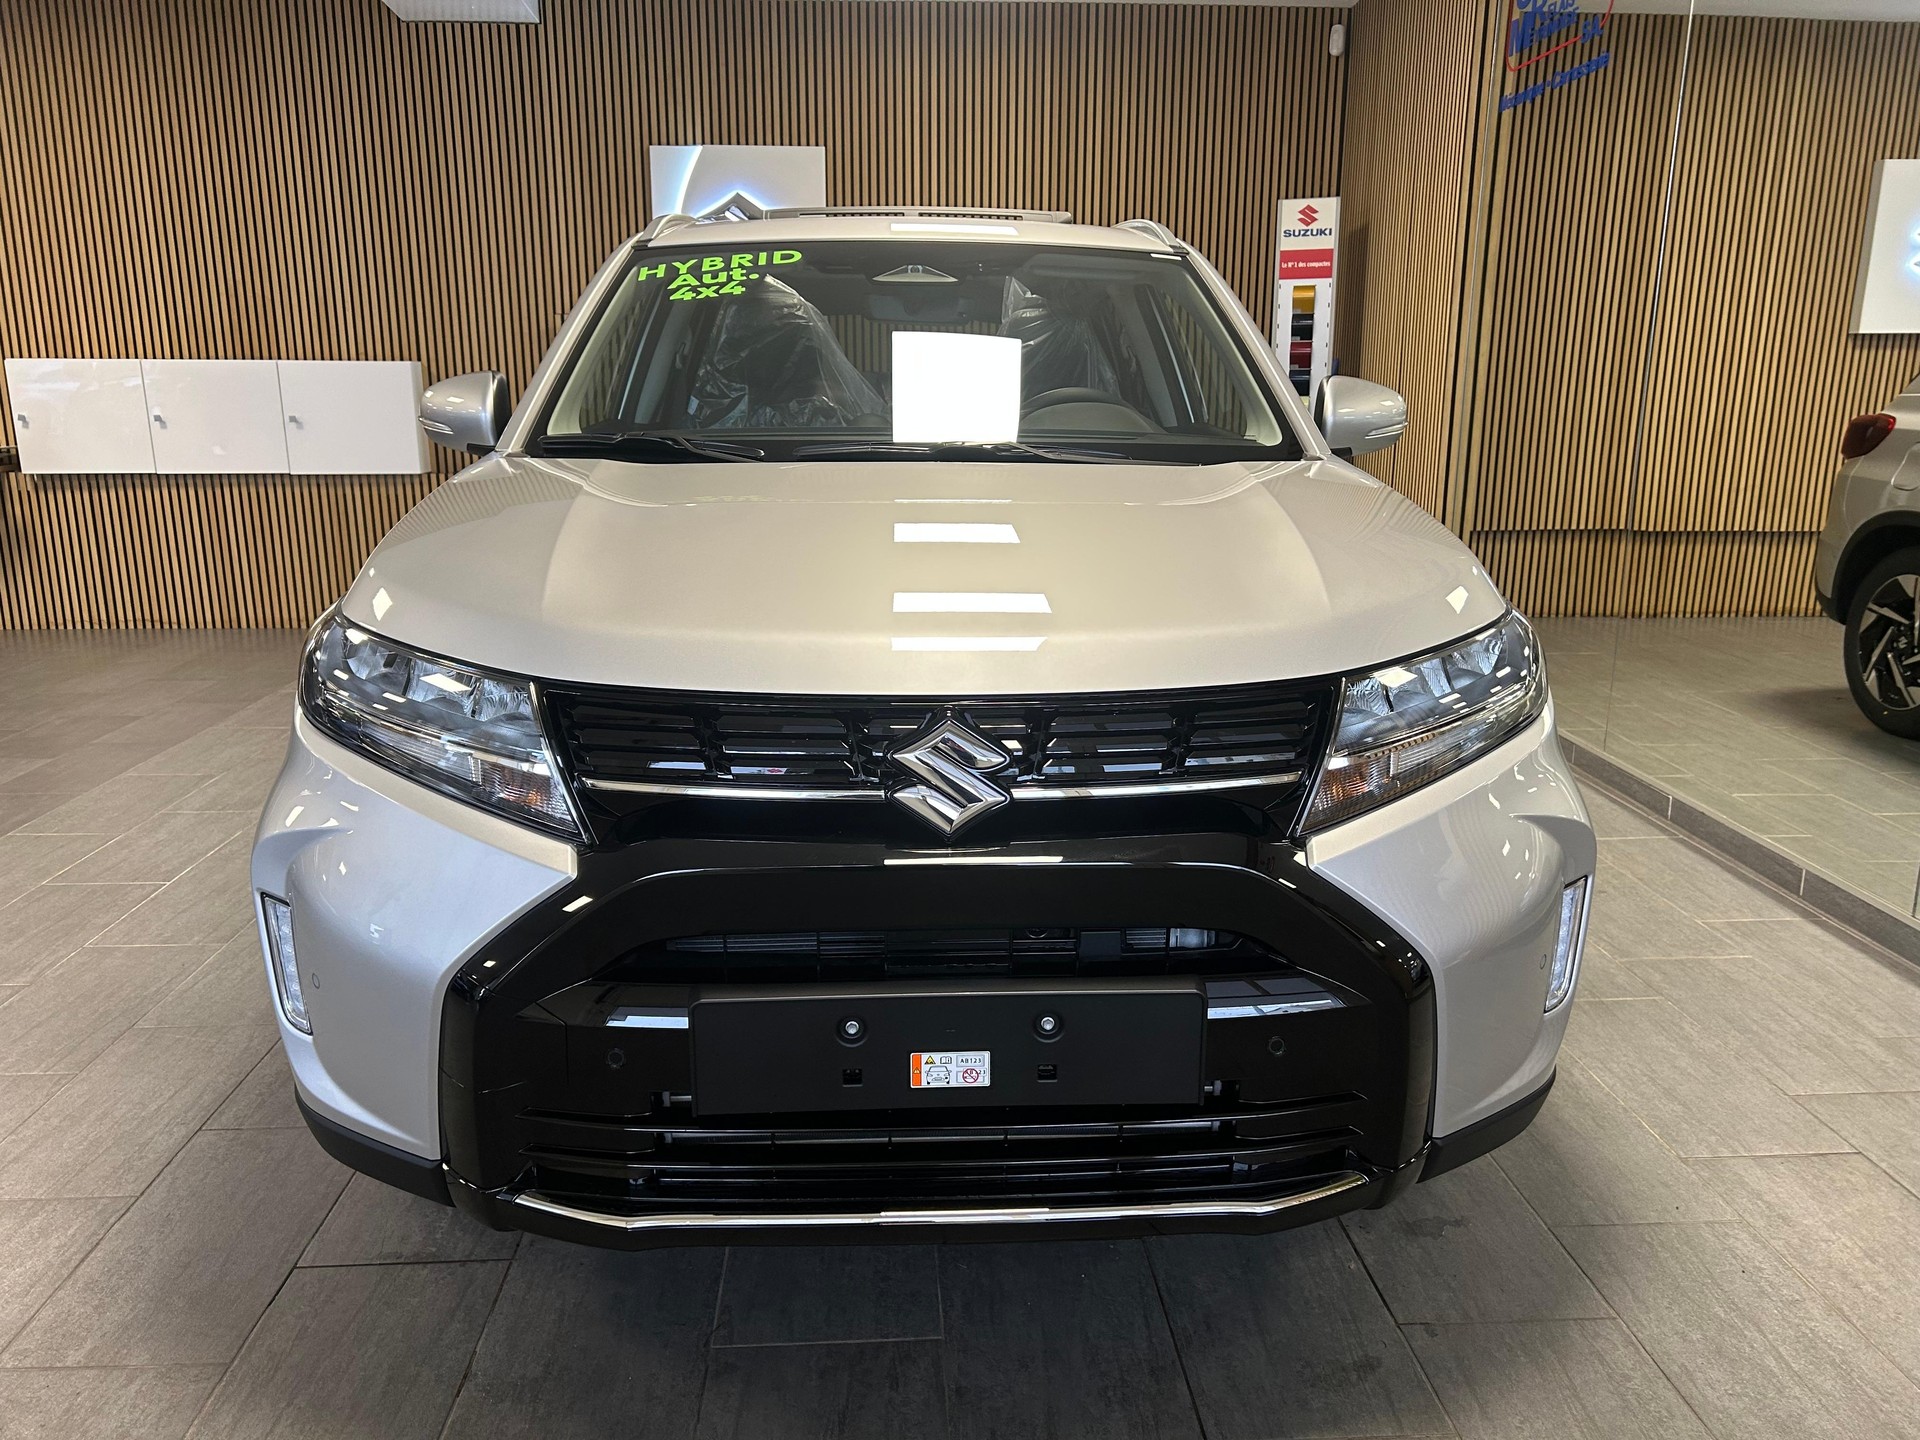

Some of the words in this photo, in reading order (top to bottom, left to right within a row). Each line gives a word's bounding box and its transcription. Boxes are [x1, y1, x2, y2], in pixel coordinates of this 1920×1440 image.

[1283, 228, 1332, 237] SUZUKI
[638, 250, 803, 281] HYBRID
[667, 268, 760, 290] Aut.
[669, 280, 746, 301] 4x4
